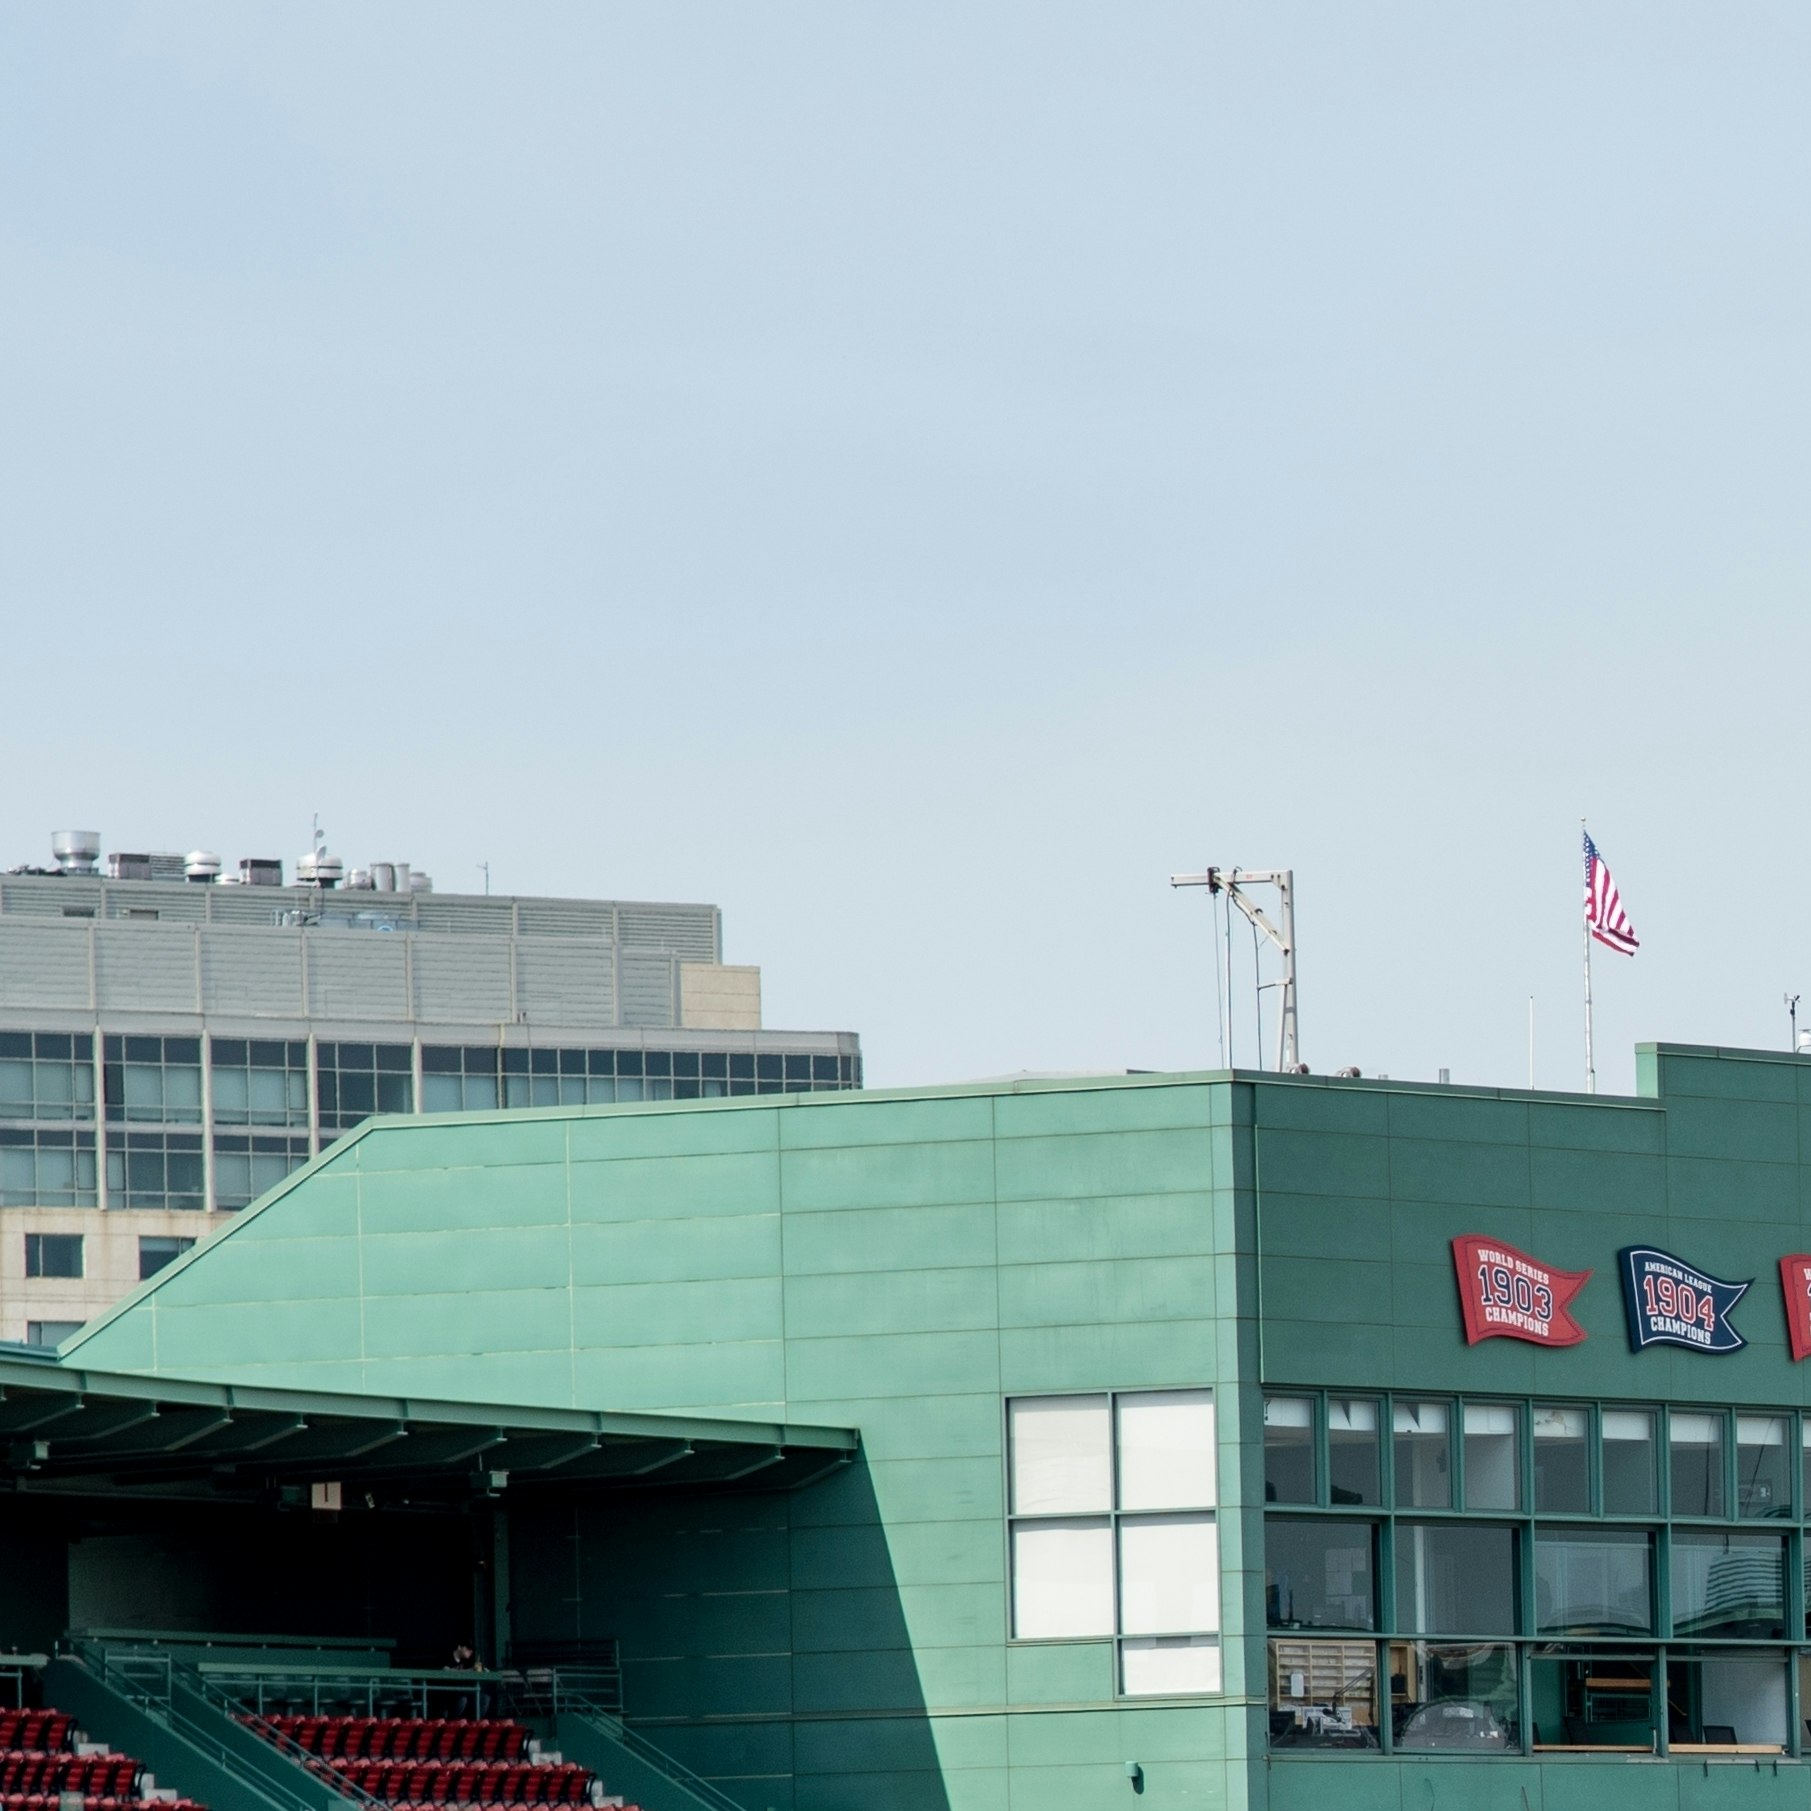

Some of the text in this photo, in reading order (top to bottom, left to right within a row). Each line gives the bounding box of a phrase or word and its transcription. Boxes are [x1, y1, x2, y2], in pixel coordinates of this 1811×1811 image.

[1479, 1249, 1549, 1284] WORLD SERIES
[1645, 1262, 1713, 1294] AMERICAN LEAGUE
[1478, 1265, 1552, 1321] 1903
[1644, 1275, 1714, 1331] 1904
[1485, 1307, 1549, 1336] CHAMPIONS
[1650, 1316, 1711, 1345] CHAMPIONS
